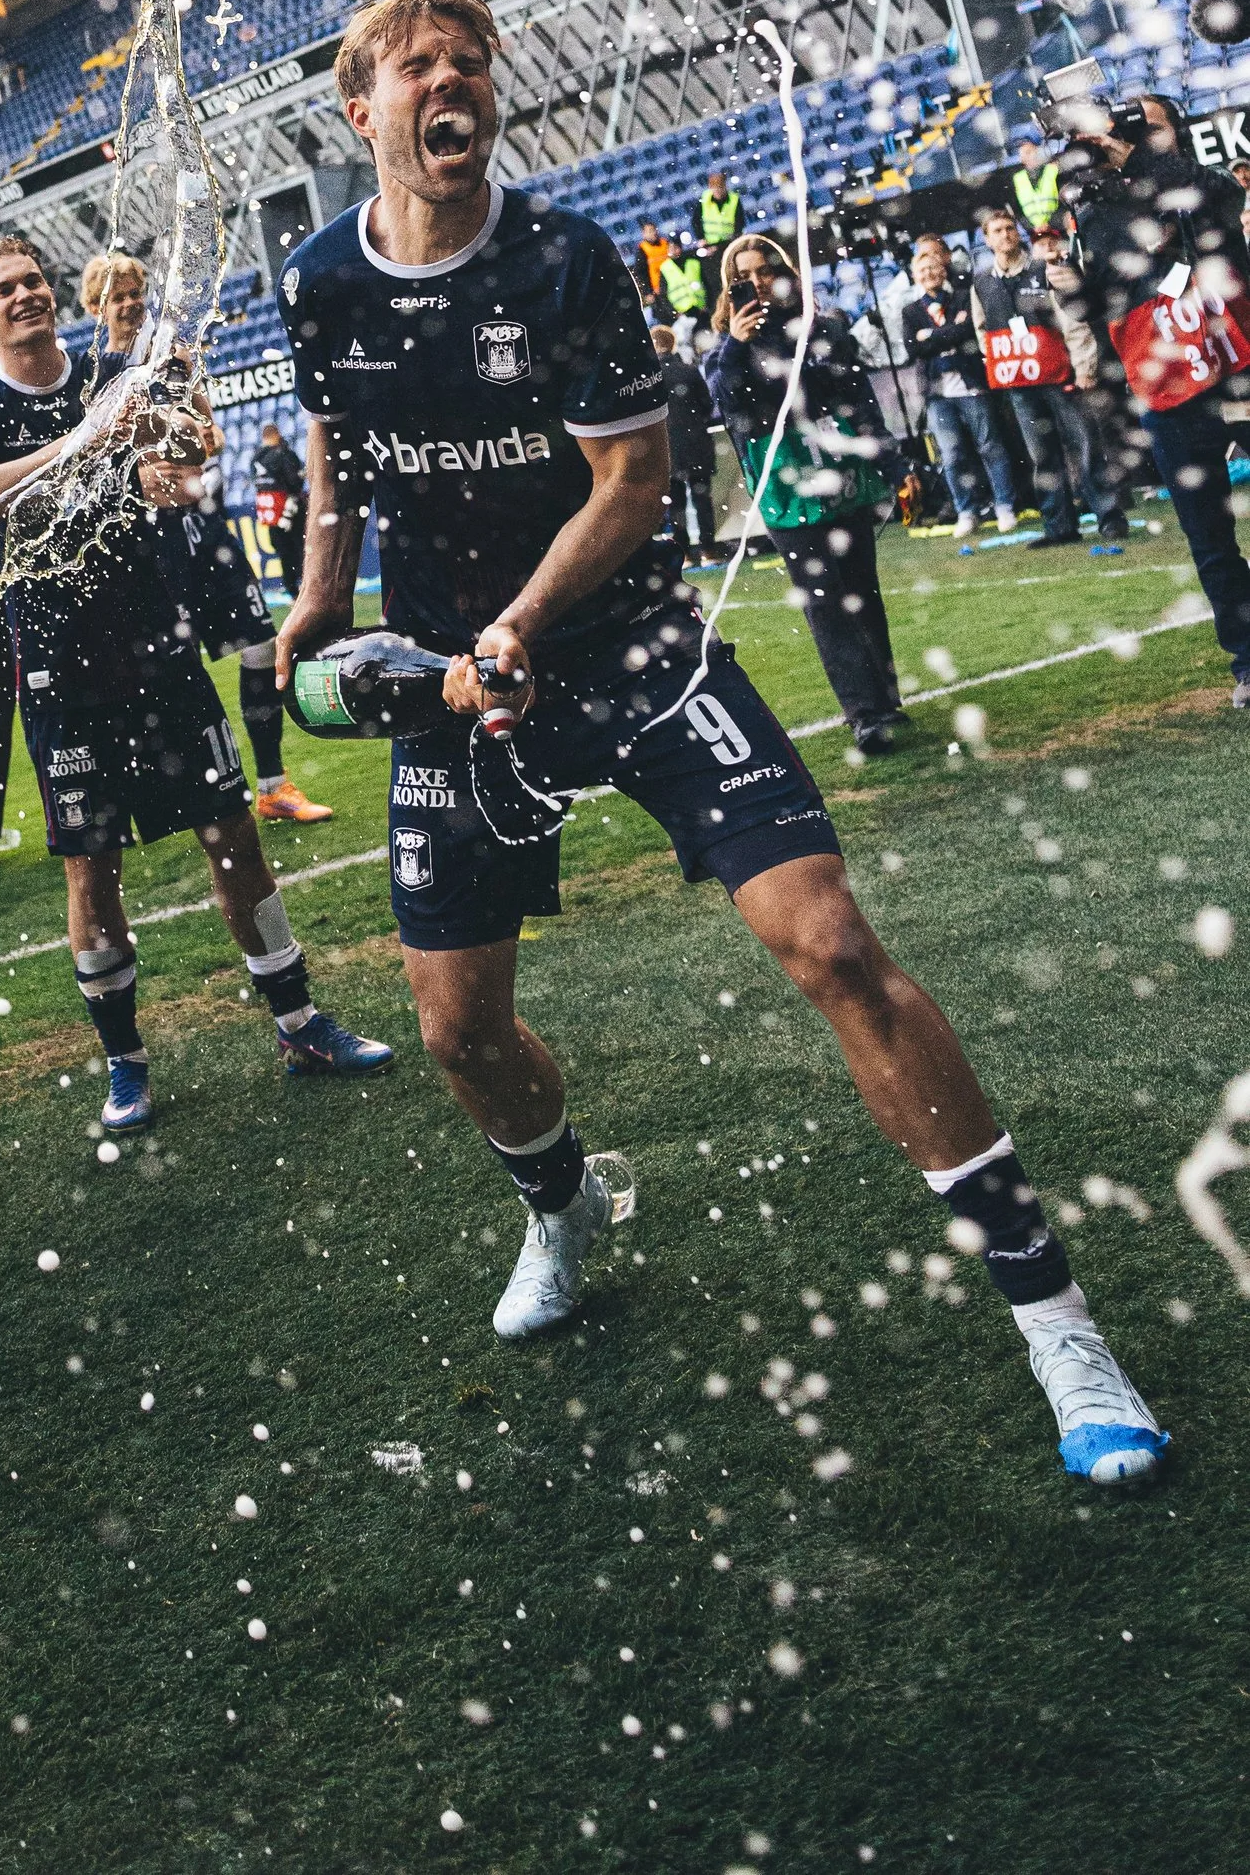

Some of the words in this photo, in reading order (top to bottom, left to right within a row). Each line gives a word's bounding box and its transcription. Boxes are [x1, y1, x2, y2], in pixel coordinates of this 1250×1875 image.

[391, 297, 437, 309] CRAFT
[390, 426, 550, 474] bravida
[685, 693, 751, 765] 9
[53, 745, 91, 764] FAXE
[203, 718, 240, 776] 10
[49, 758, 97, 778] KONDI
[397, 765, 449, 787] FAXE
[719, 767, 773, 793] CRAFT
[393, 785, 456, 808] KONDI
